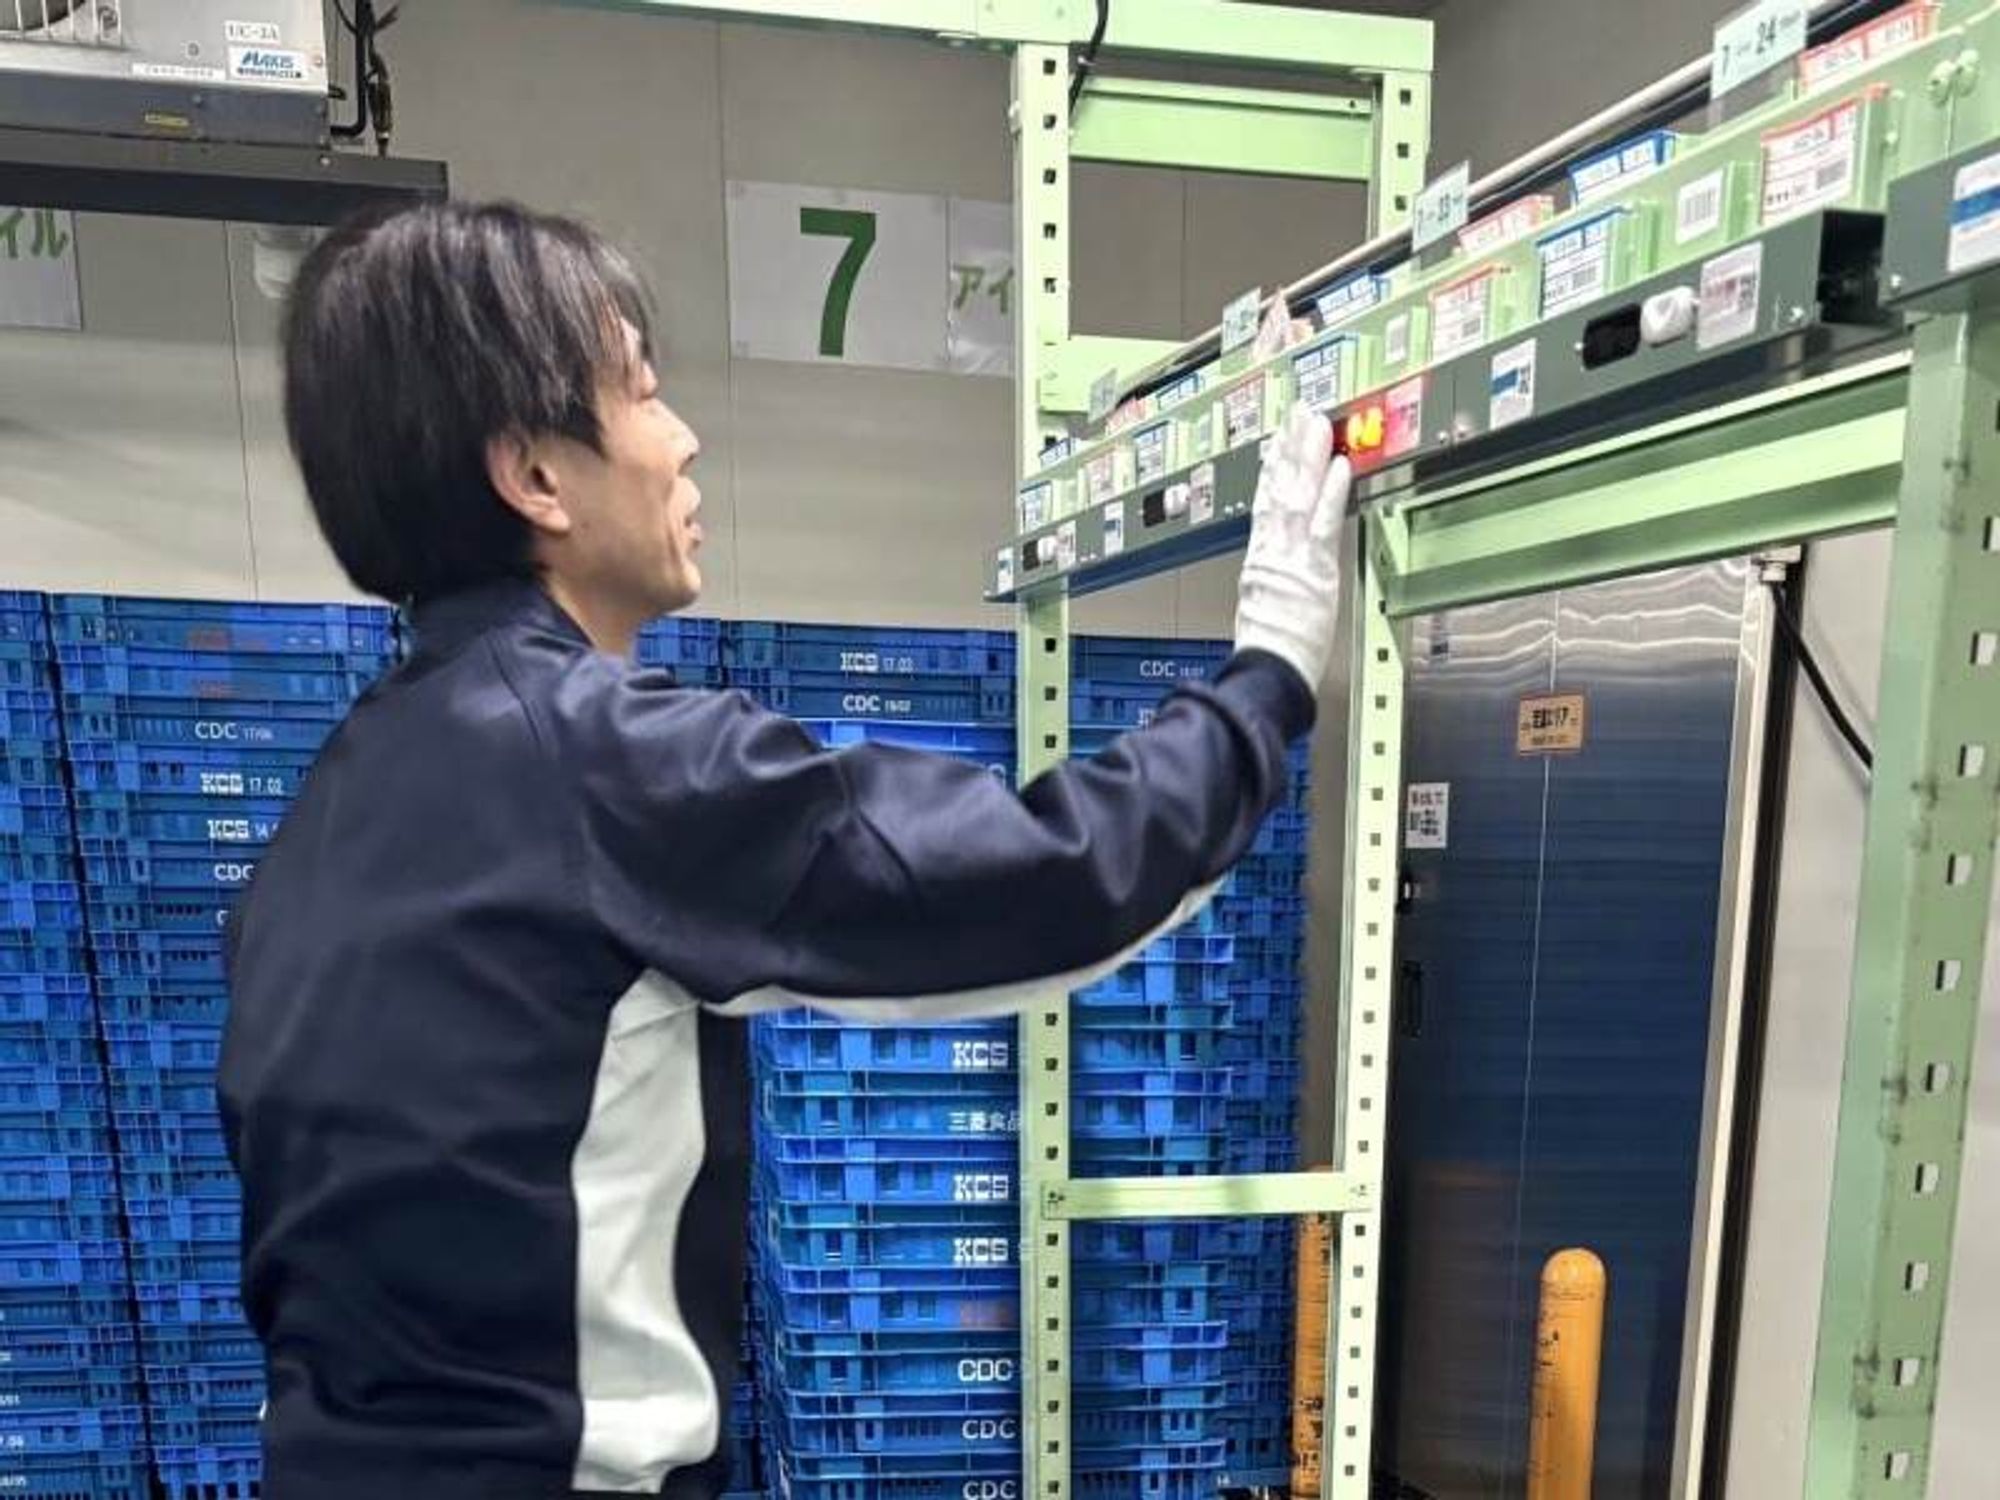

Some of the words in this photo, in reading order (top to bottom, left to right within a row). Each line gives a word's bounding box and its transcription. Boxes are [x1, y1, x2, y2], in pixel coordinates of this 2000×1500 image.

[800, 207, 876, 357] 7
[1139, 660, 1176, 677] CDC
[842, 694, 880, 712] CDC
[195, 722, 238, 739] CDC
[208, 820, 250, 839] KCS
[214, 864, 255, 881] CDC
[952, 1042, 1009, 1067] KCS
[954, 1175, 1009, 1200] KCS
[954, 1239, 1009, 1262] KCS
[958, 1359, 1013, 1381] CDC
[961, 1420, 1016, 1439] CDC
[962, 1480, 1017, 1500] CDC
